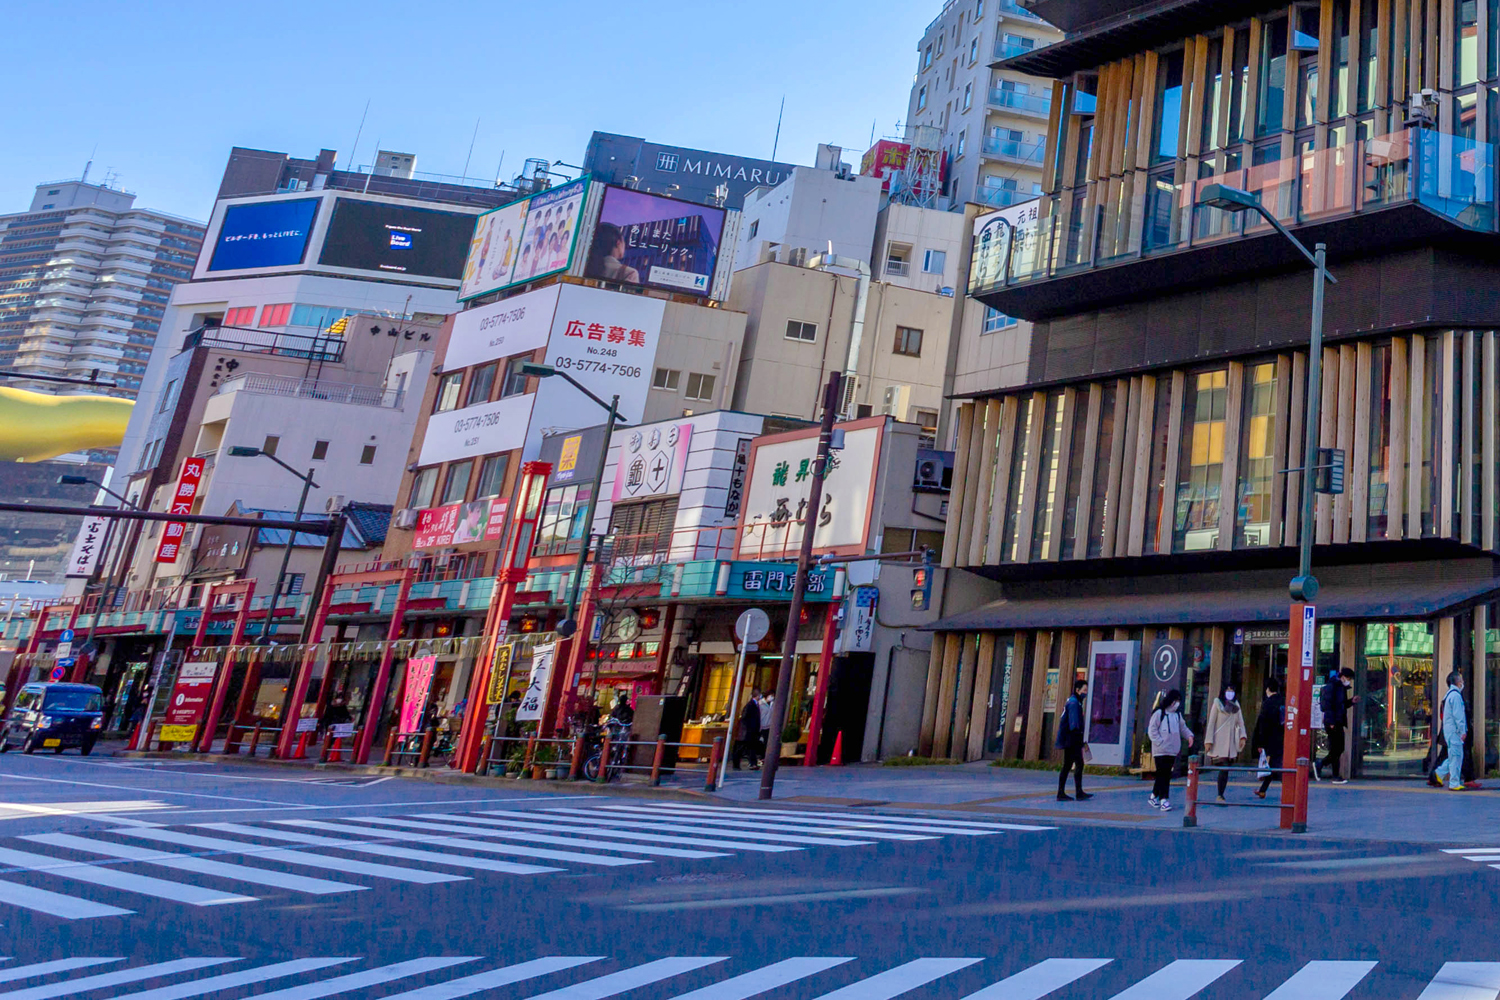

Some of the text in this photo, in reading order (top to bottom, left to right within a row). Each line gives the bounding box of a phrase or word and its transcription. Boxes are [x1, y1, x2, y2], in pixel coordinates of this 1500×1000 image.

[682, 158, 780, 186] MIMARU
[628, 240, 693, 259] ヒューリック。
[479, 307, 526, 331] 03-5774-7506
[564, 319, 647, 348] 広告募集
[587, 346, 618, 358] No.248
[555, 356, 642, 379] 03-5774-7506
[454, 412, 500, 434] 03-5774-7506
[728, 452, 745, 513] 亀十もなか
[160, 463, 200, 559] 丸勝不動産
